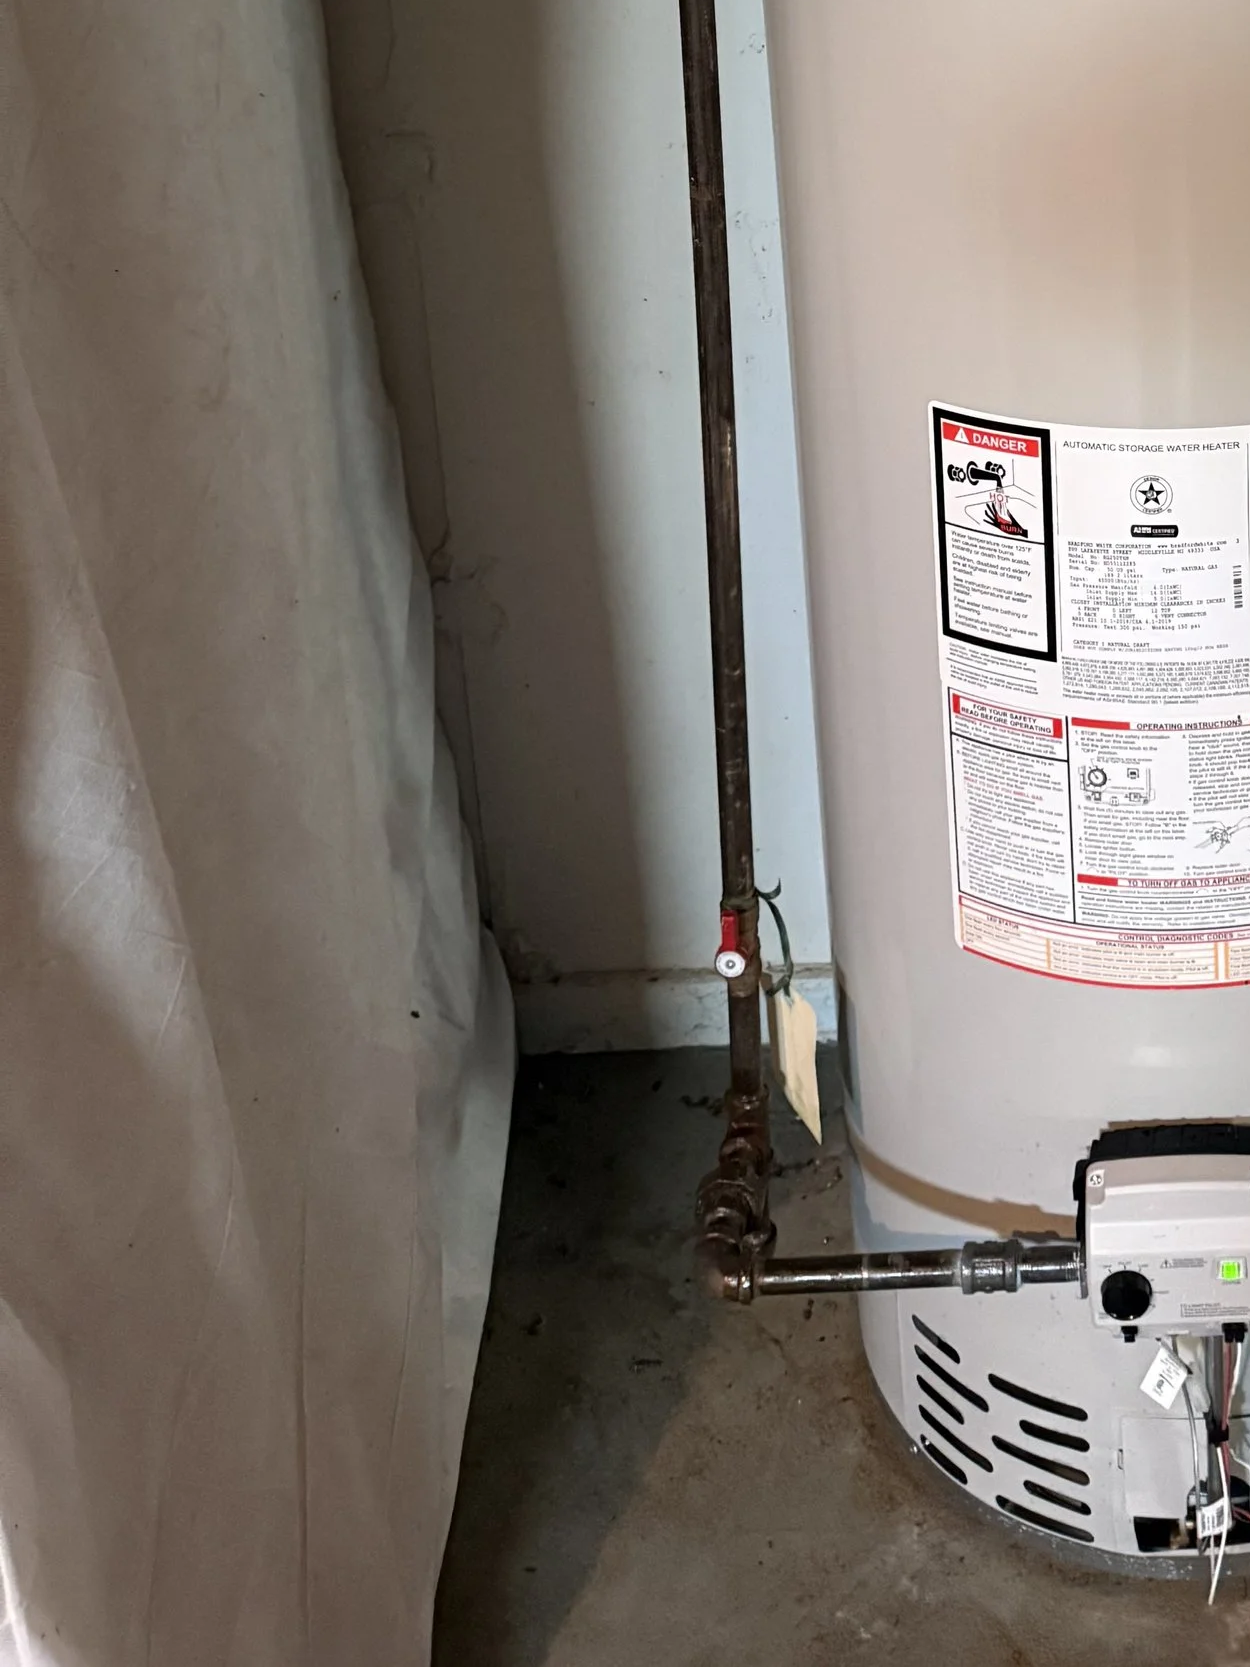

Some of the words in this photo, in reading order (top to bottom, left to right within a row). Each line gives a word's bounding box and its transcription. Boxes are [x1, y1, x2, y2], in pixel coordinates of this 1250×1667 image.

[972, 433, 1027, 452] DANGER
[1063, 442, 1116, 451] AUTOMATIC
[1166, 444, 1200, 452] WATER
[1202, 442, 1240, 451] HEATER
[989, 492, 1009, 503] HOT
[1000, 524, 1023, 534] BURN
[973, 704, 987, 713] FOR
[989, 709, 1008, 718] YOUR
[1009, 714, 1036, 724] SAFETY
[961, 707, 979, 717] READ
[980, 713, 1008, 725] BEFORE
[1010, 720, 1052, 734] OPERATING
[1184, 720, 1243, 730] INSTRUCTIONS
